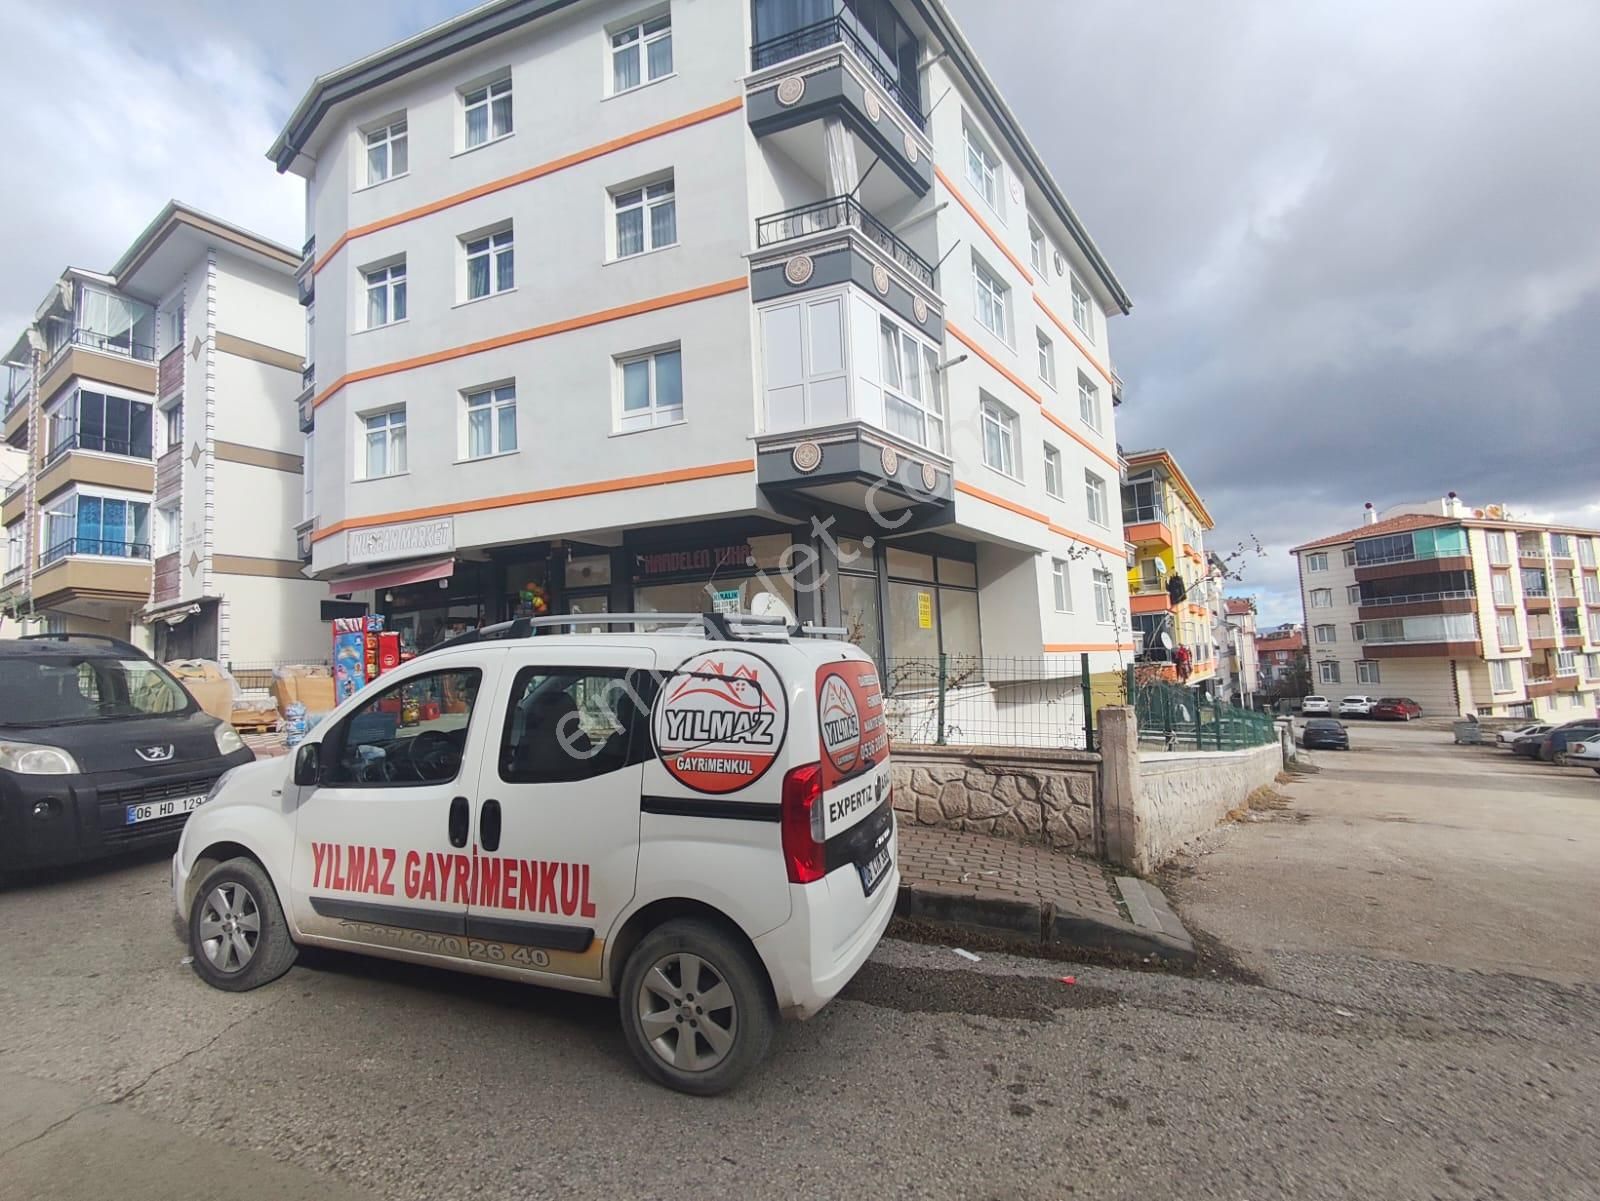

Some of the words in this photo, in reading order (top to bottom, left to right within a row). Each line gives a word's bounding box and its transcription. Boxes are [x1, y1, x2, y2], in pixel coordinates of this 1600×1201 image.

[400, 520, 450, 550] MARKET
[666, 709, 775, 745] YILMAZ
[824, 715, 858, 746] YILMAZ
[136, 807, 152, 820] 06
[159, 802, 174, 815] HD
[311, 842, 396, 896] YILMAZ
[404, 844, 596, 918] GAYRİMENKUL
[468, 941, 504, 961] 26
[512, 947, 549, 968] 40
